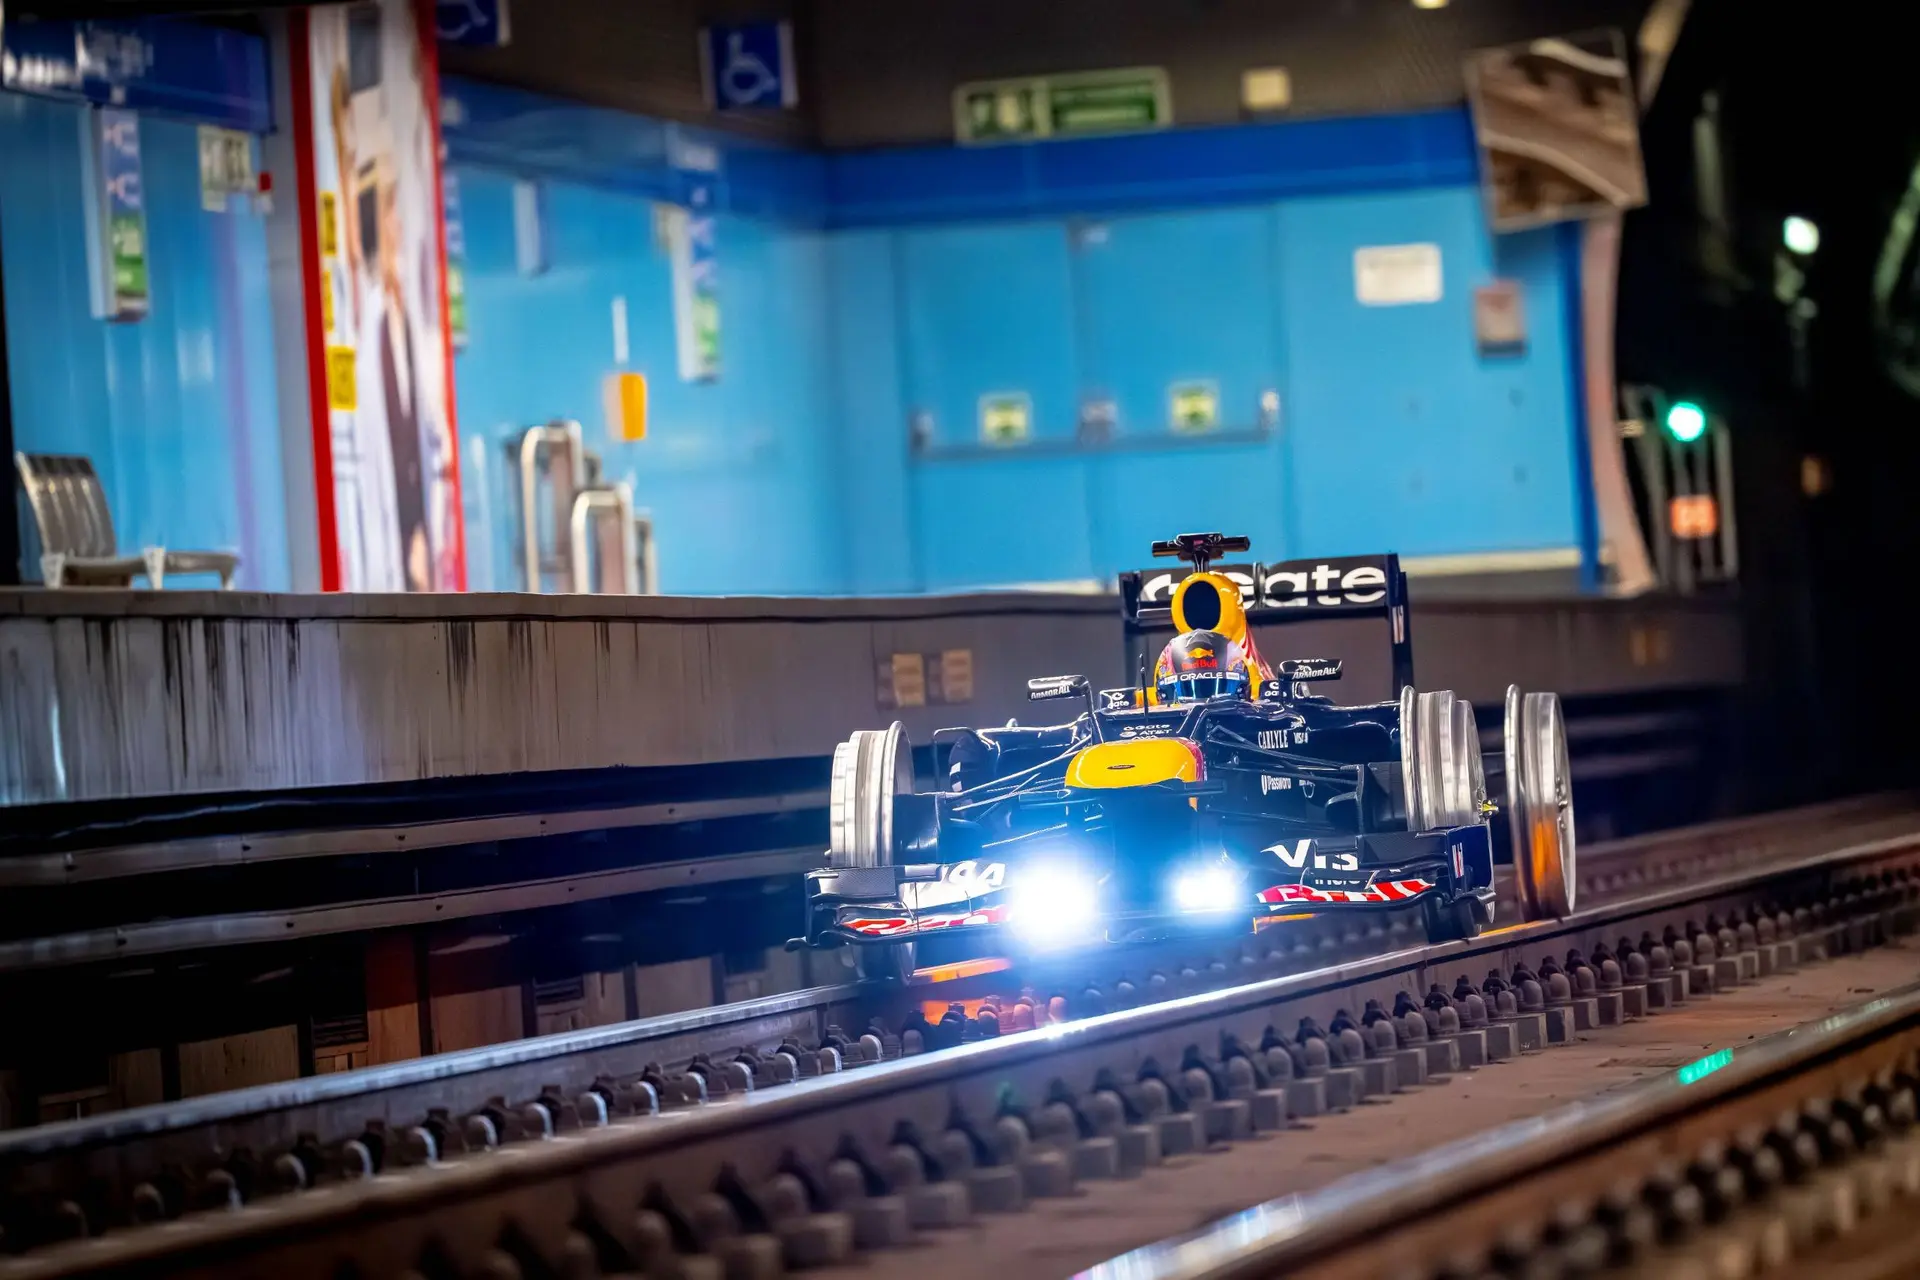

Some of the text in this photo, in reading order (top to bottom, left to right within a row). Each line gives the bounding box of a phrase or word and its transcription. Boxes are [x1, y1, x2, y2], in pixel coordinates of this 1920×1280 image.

[1180, 671, 1223, 681] ORACLE
[1258, 729, 1288, 749] CARLYLE
[1260, 838, 1359, 871] VIS
